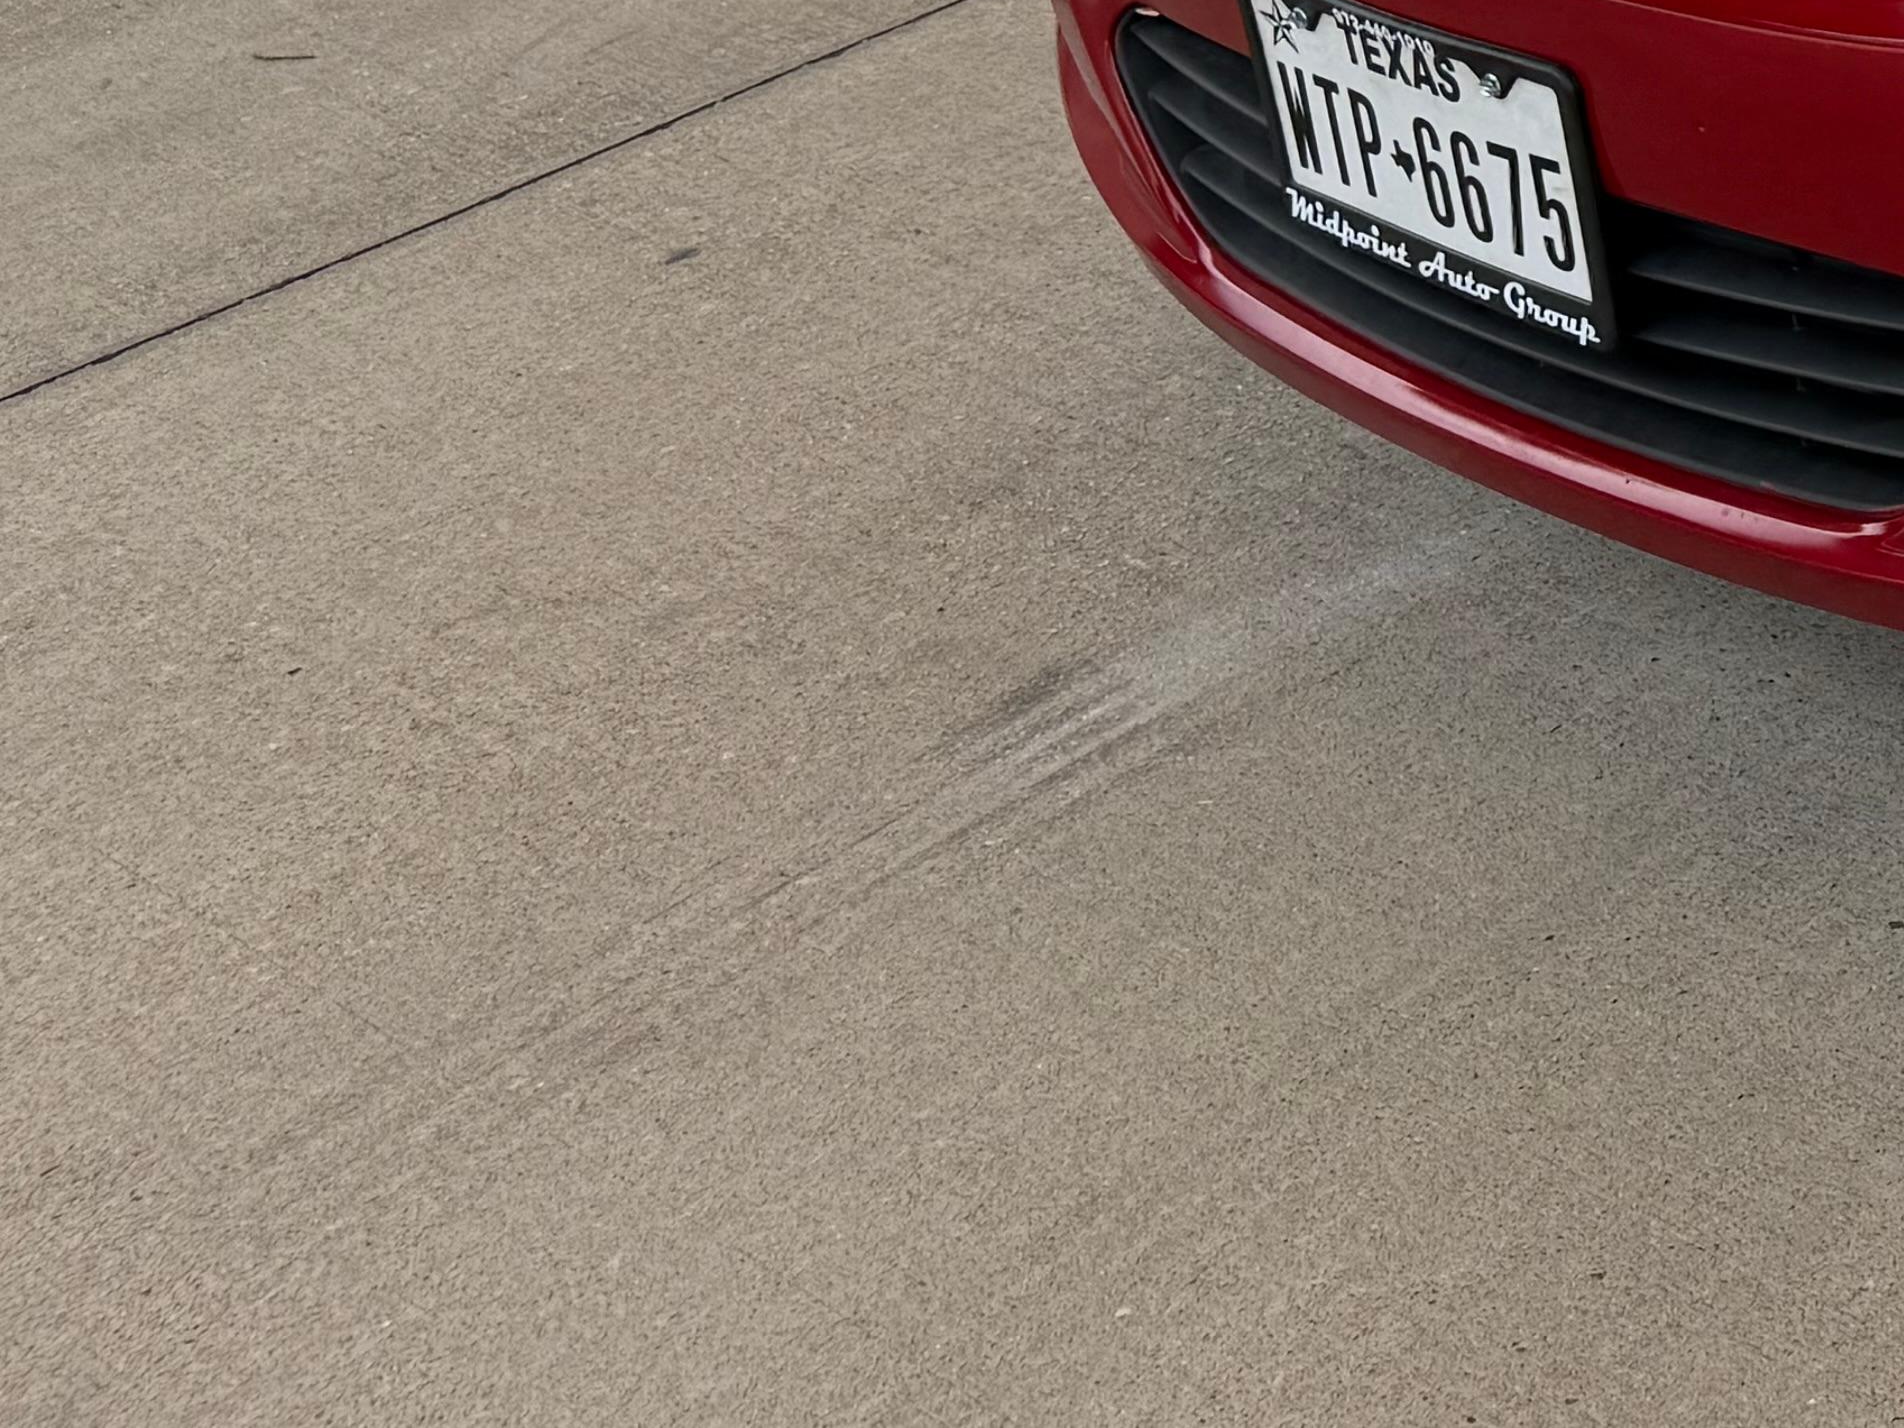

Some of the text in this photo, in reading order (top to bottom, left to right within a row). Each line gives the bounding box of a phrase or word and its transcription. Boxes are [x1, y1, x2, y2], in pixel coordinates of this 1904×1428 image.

[1336, 24, 1461, 103] TEXAS
[1286, 187, 1601, 346] Midpoint Auto Group
